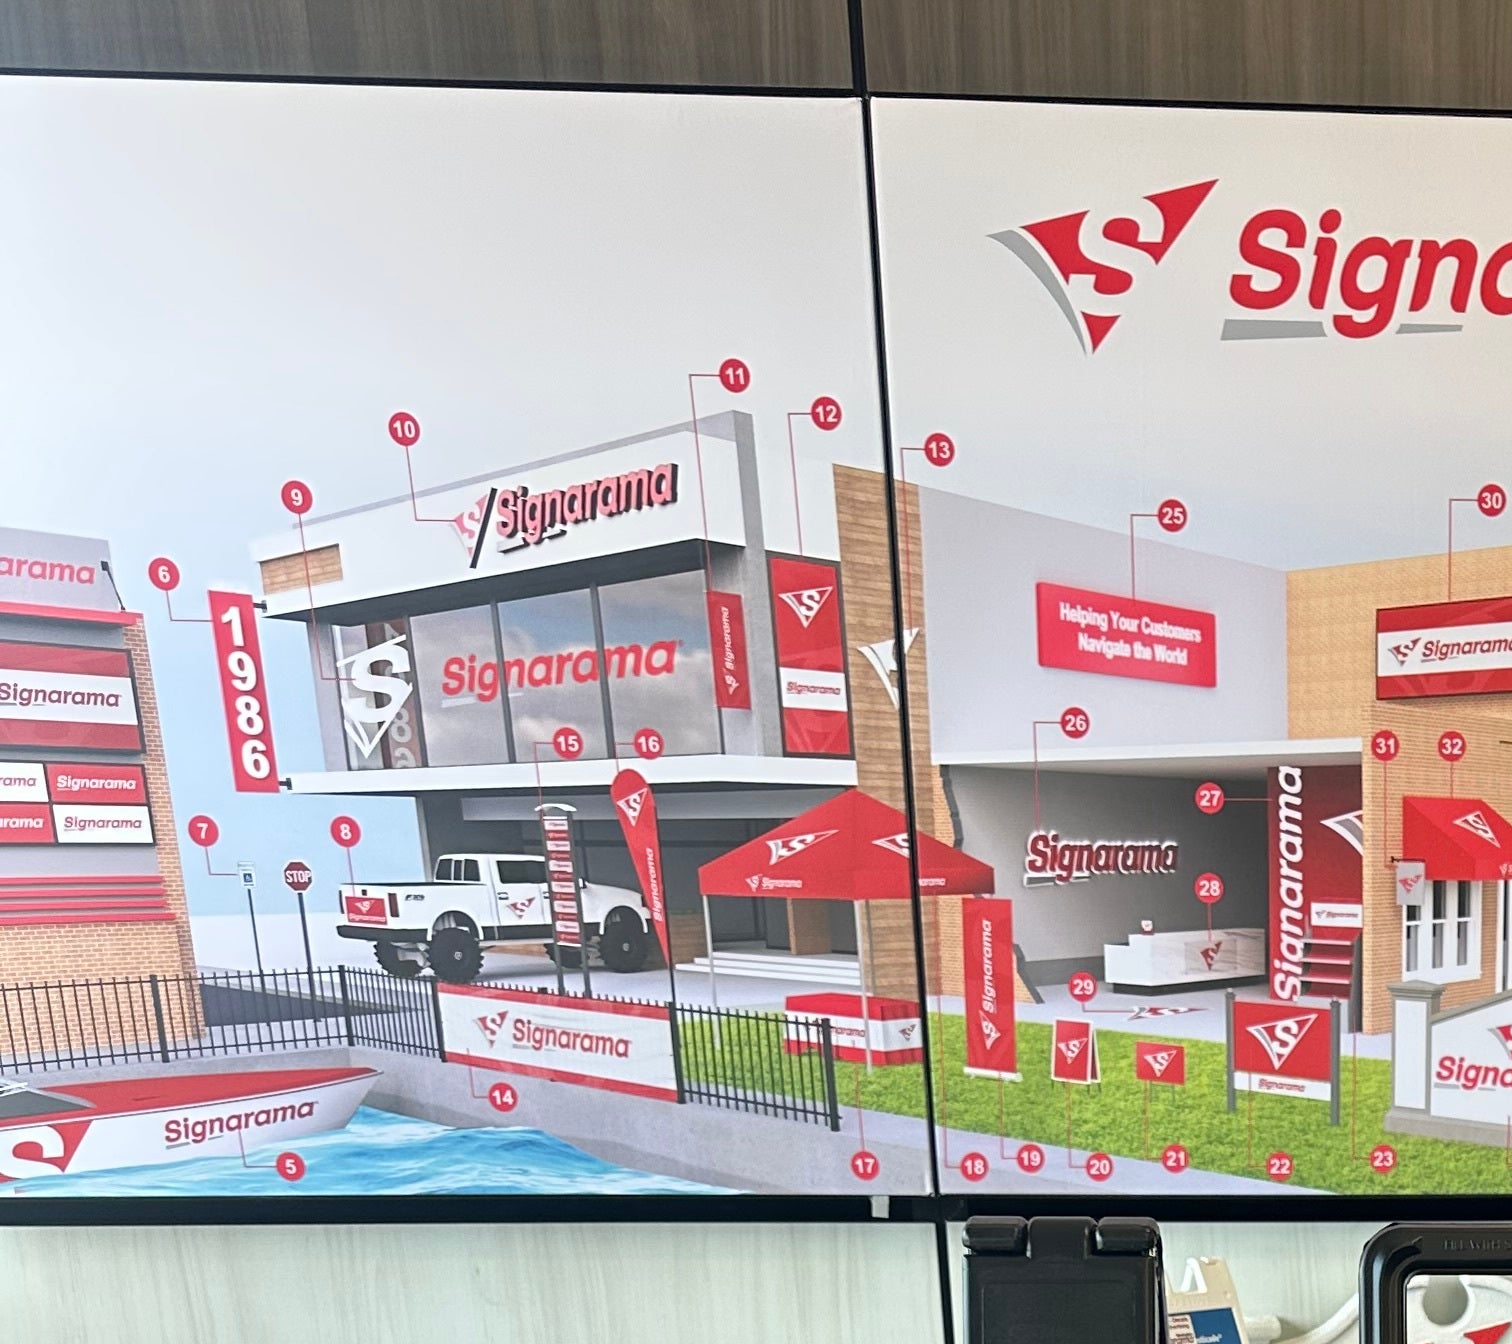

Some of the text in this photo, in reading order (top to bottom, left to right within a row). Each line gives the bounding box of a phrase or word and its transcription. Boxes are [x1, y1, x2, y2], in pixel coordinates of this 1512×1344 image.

[496, 464, 678, 546] Signarama
[1480, 492, 1505, 510] 30
[1059, 602, 1202, 643] Helping Your Customers
[1078, 632, 1188, 666] Navigate the World
[442, 640, 678, 702] Signarama
[220, 606, 271, 779] 1986
[285, 869, 312, 884] STOP
[1027, 833, 1178, 884] Signarama
[512, 1018, 631, 1058] Signarama
[165, 1102, 314, 1144] Signarama
